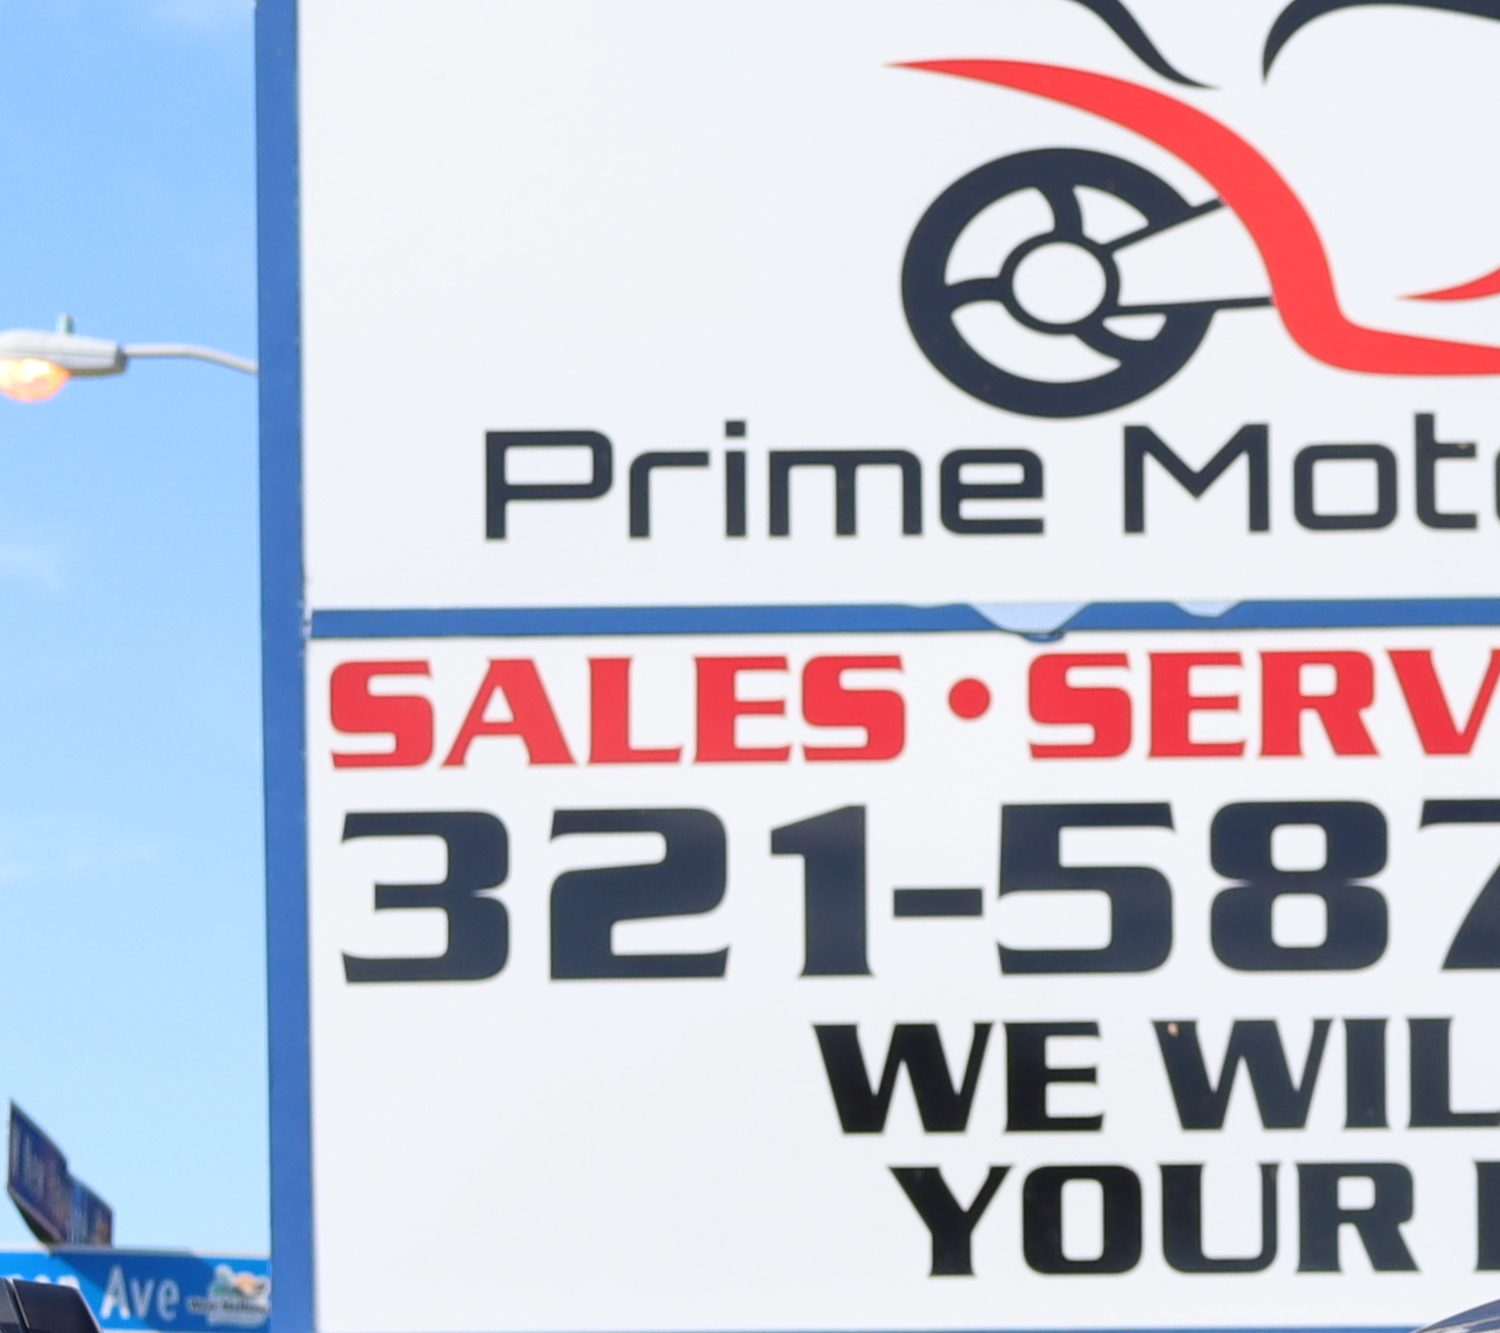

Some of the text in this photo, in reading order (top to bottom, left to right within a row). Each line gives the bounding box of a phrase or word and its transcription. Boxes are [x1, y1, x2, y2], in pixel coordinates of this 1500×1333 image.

[486, 425, 1043, 539] Prime
[330, 655, 906, 768] SALES
[815, 1022, 1102, 1133] WE
[891, 1163, 1416, 1275] YOUR
[100, 1264, 181, 1321] Ave
